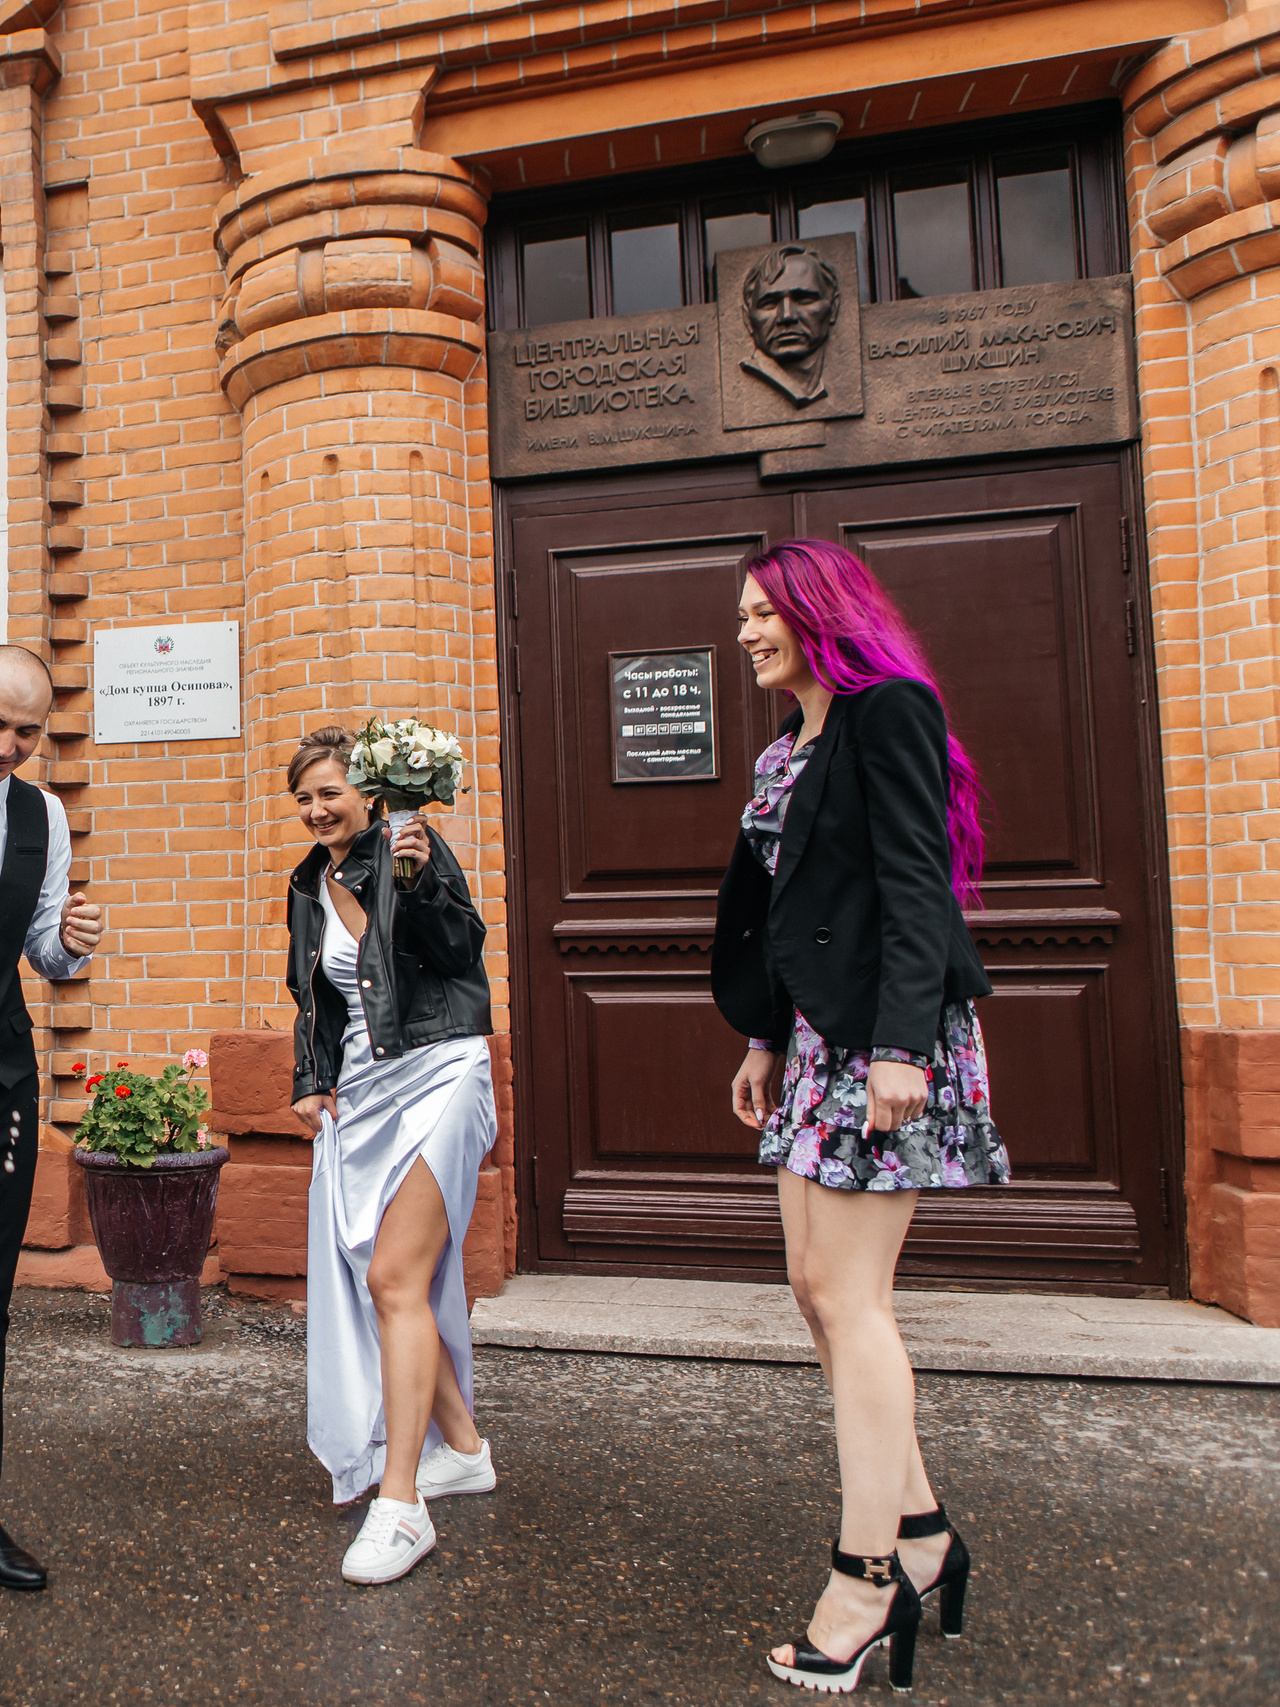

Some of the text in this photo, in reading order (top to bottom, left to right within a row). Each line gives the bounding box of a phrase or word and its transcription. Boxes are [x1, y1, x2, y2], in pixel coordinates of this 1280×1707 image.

[939, 300, 1038, 325] В 1967 ГОДУ
[514, 322, 700, 368] ЦЕНТРАЛЬНАЯ
[868, 315, 1117, 360] ВАСИЛИЙ МАКАРОВИЧ
[940, 347, 1041, 374] ШУКШИН
[528, 353, 687, 392] ГОРОДСКАЯ
[907, 372, 1080, 403] ВПЕРВЫЕ ВСТРЕТИЛСЯ
[524, 383, 695, 421] БИБЛИОТЕКА
[891, 397, 1002, 423] ЦЕНТРАЛЬНОЙ
[1012, 387, 1114, 410] БИБЛИОТЕКЕ
[914, 417, 1016, 438] ЧИТАТЕЛЯМИ
[1025, 409, 1093, 428] ГОРОДА
[525, 435, 580, 452] ИМЕНИ
[126, 667, 174, 675] РЕГИОНАЛЬНОГО
[140, 660, 179, 668] КУЛЬТУРНОГО
[180, 658, 212, 666] НАСЛЕДИЯ
[624, 668, 699, 681] Часы работы:
[99, 681, 233, 697] «Дом купца Осипова»,
[623, 684, 702, 699] с 11 до 18 ч.
[148, 696, 185, 707] 1897 г.
[624, 705, 655, 714] Выходной
[660, 704, 701, 712] воскресенье
[160, 717, 208, 725] ГОСУДАРСТВОМ
[627, 749, 660, 757] Последний
